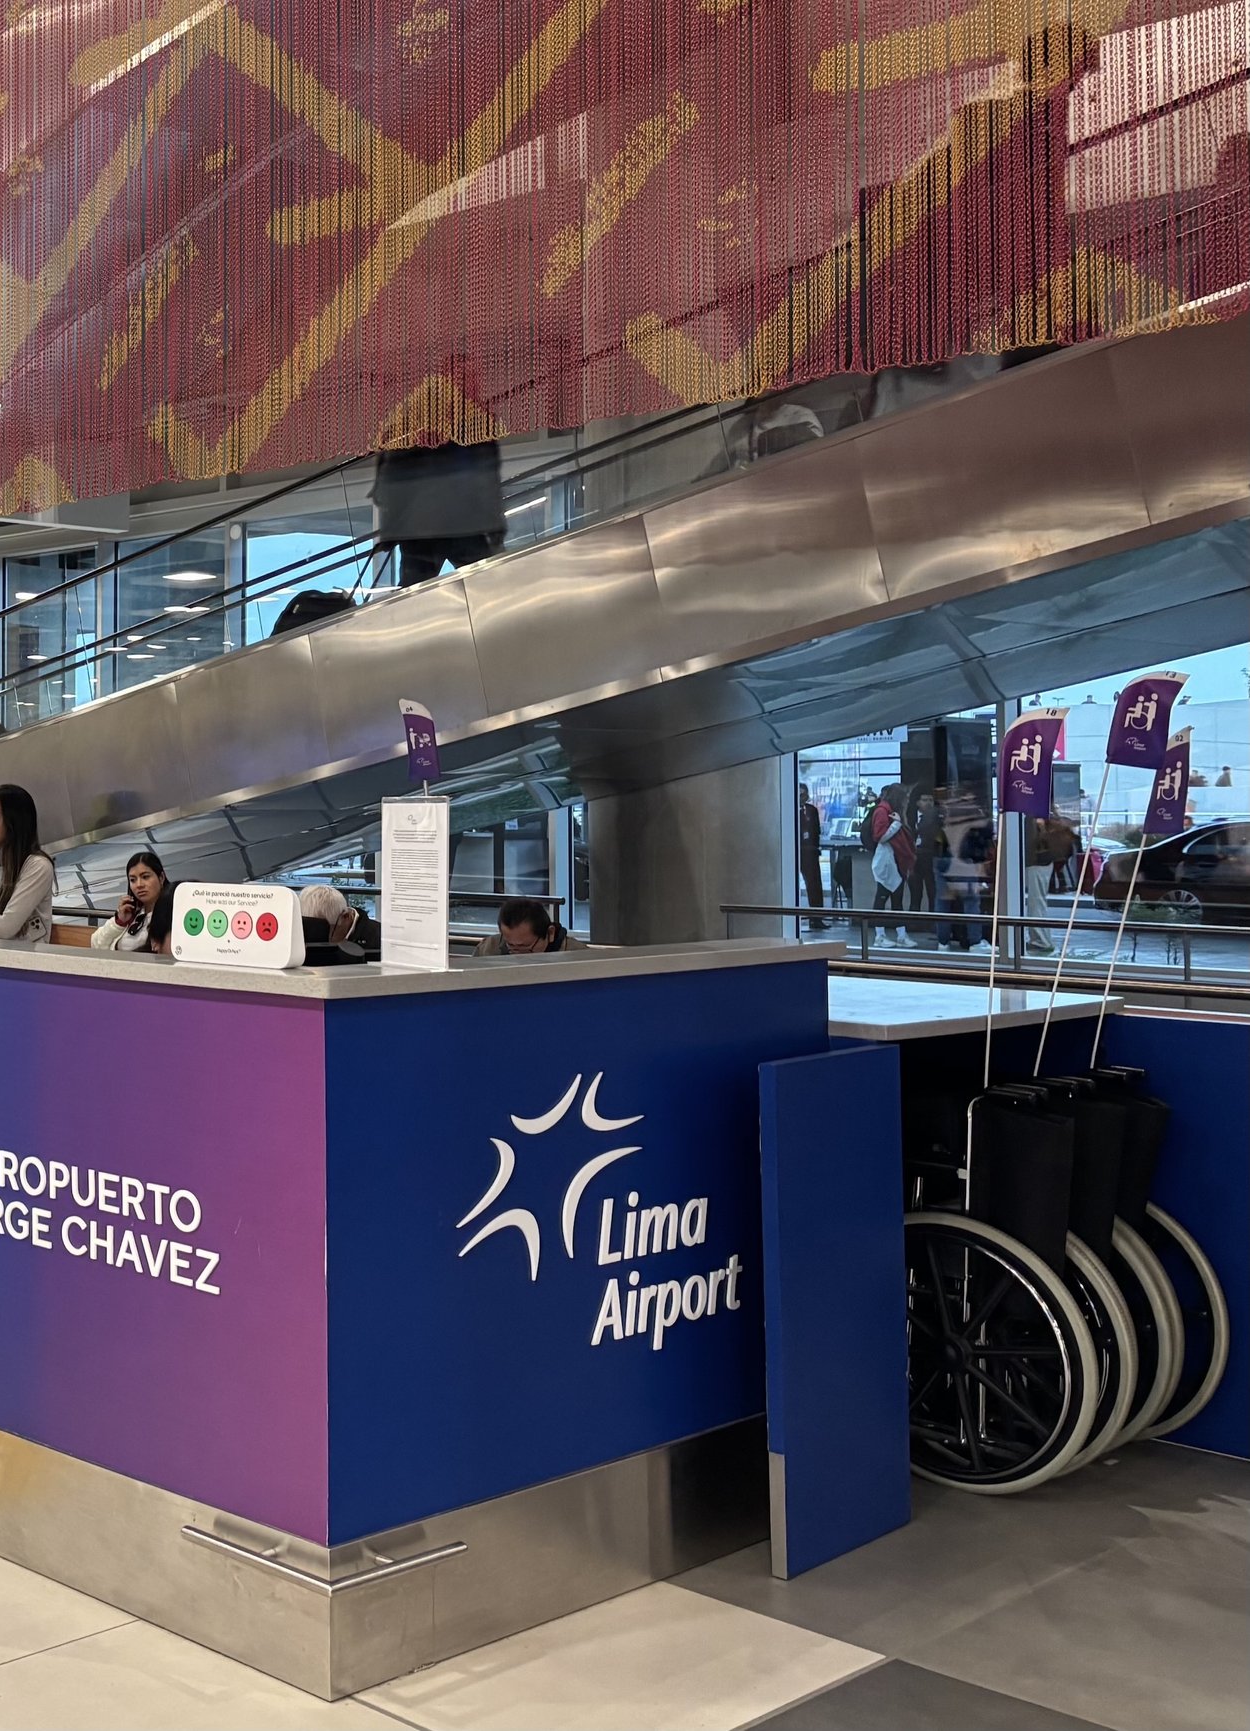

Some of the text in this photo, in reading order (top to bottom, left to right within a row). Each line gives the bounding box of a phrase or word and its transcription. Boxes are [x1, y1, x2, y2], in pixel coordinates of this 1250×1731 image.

[1046, 708, 1057, 716] 18
[1175, 734, 1184, 742] 02
[61, 1215, 220, 1295] CHAVEZ
[598, 1191, 708, 1265] Lima
[591, 1254, 743, 1350] Airport
